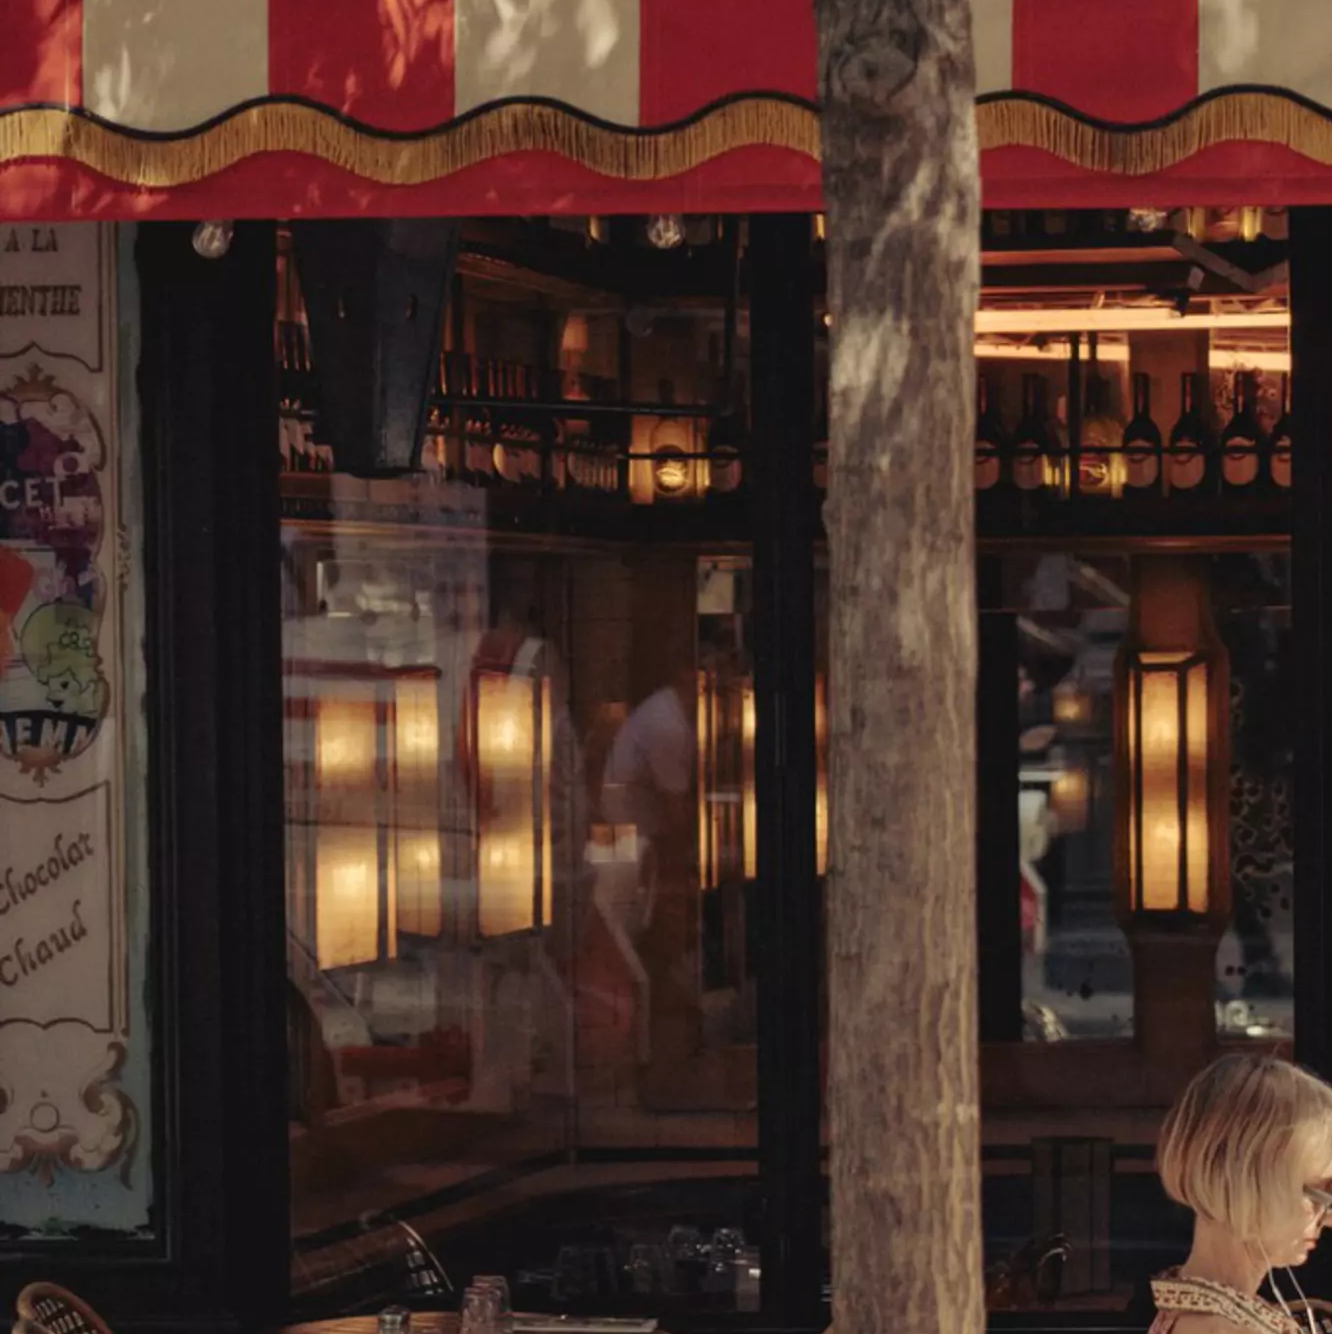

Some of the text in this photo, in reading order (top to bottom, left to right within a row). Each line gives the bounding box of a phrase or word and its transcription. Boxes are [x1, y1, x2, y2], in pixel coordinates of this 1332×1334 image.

[31, 228, 58, 253] LA
[0, 284, 82, 316] ENTHE
[0, 899, 88, 986] Chaud
